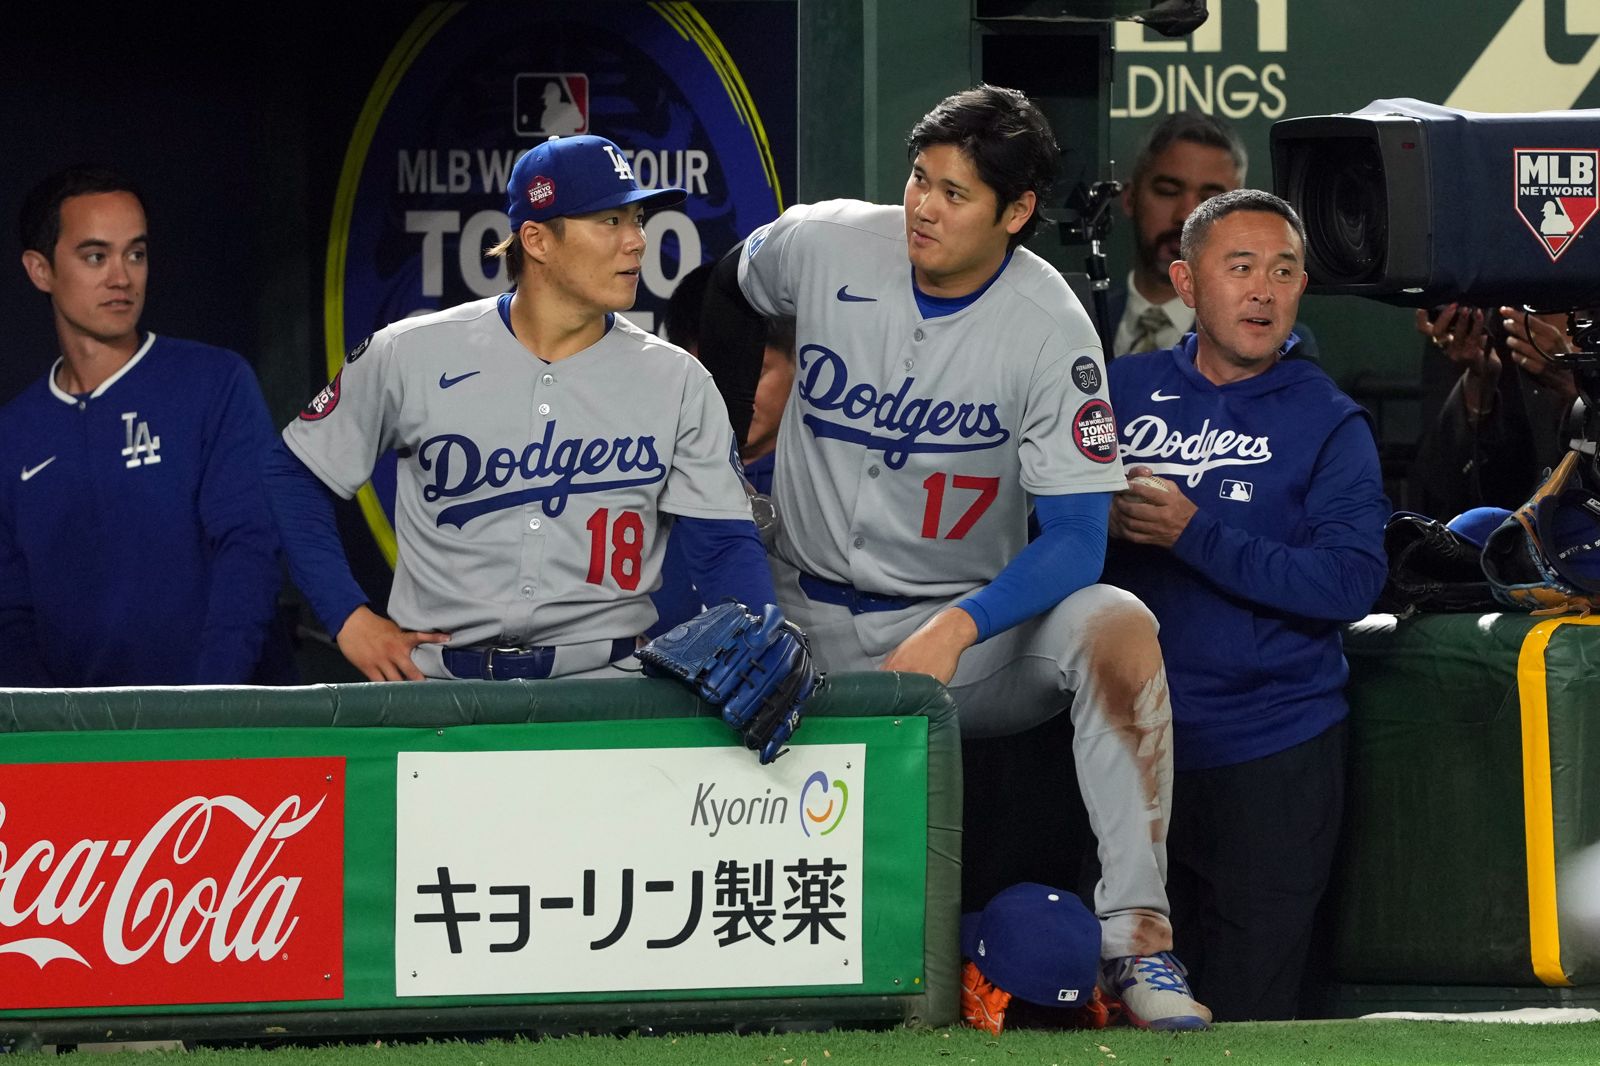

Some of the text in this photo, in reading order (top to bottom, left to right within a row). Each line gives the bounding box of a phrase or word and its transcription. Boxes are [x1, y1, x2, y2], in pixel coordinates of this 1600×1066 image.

[399, 150, 471, 194] MLB
[625, 150, 710, 195] OUR
[603, 145, 634, 180] LA
[1520, 155, 1594, 185] MLB
[1520, 186, 1593, 196] NETWORK
[406, 210, 702, 299] TOO
[1080, 369, 1098, 388] 34
[799, 343, 1010, 471] Dodgers
[1080, 422, 1114, 437] TOKYO
[121, 412, 161, 468] LA
[1082, 432, 1116, 447] SERIES
[1119, 415, 1272, 488] Dodgers
[418, 420, 667, 519] Dodgers
[921, 471, 1001, 540] 17
[585, 507, 645, 591] 18
[691, 783, 788, 837] Kyorin
[413, 857, 848, 955] キョーリン製薬
